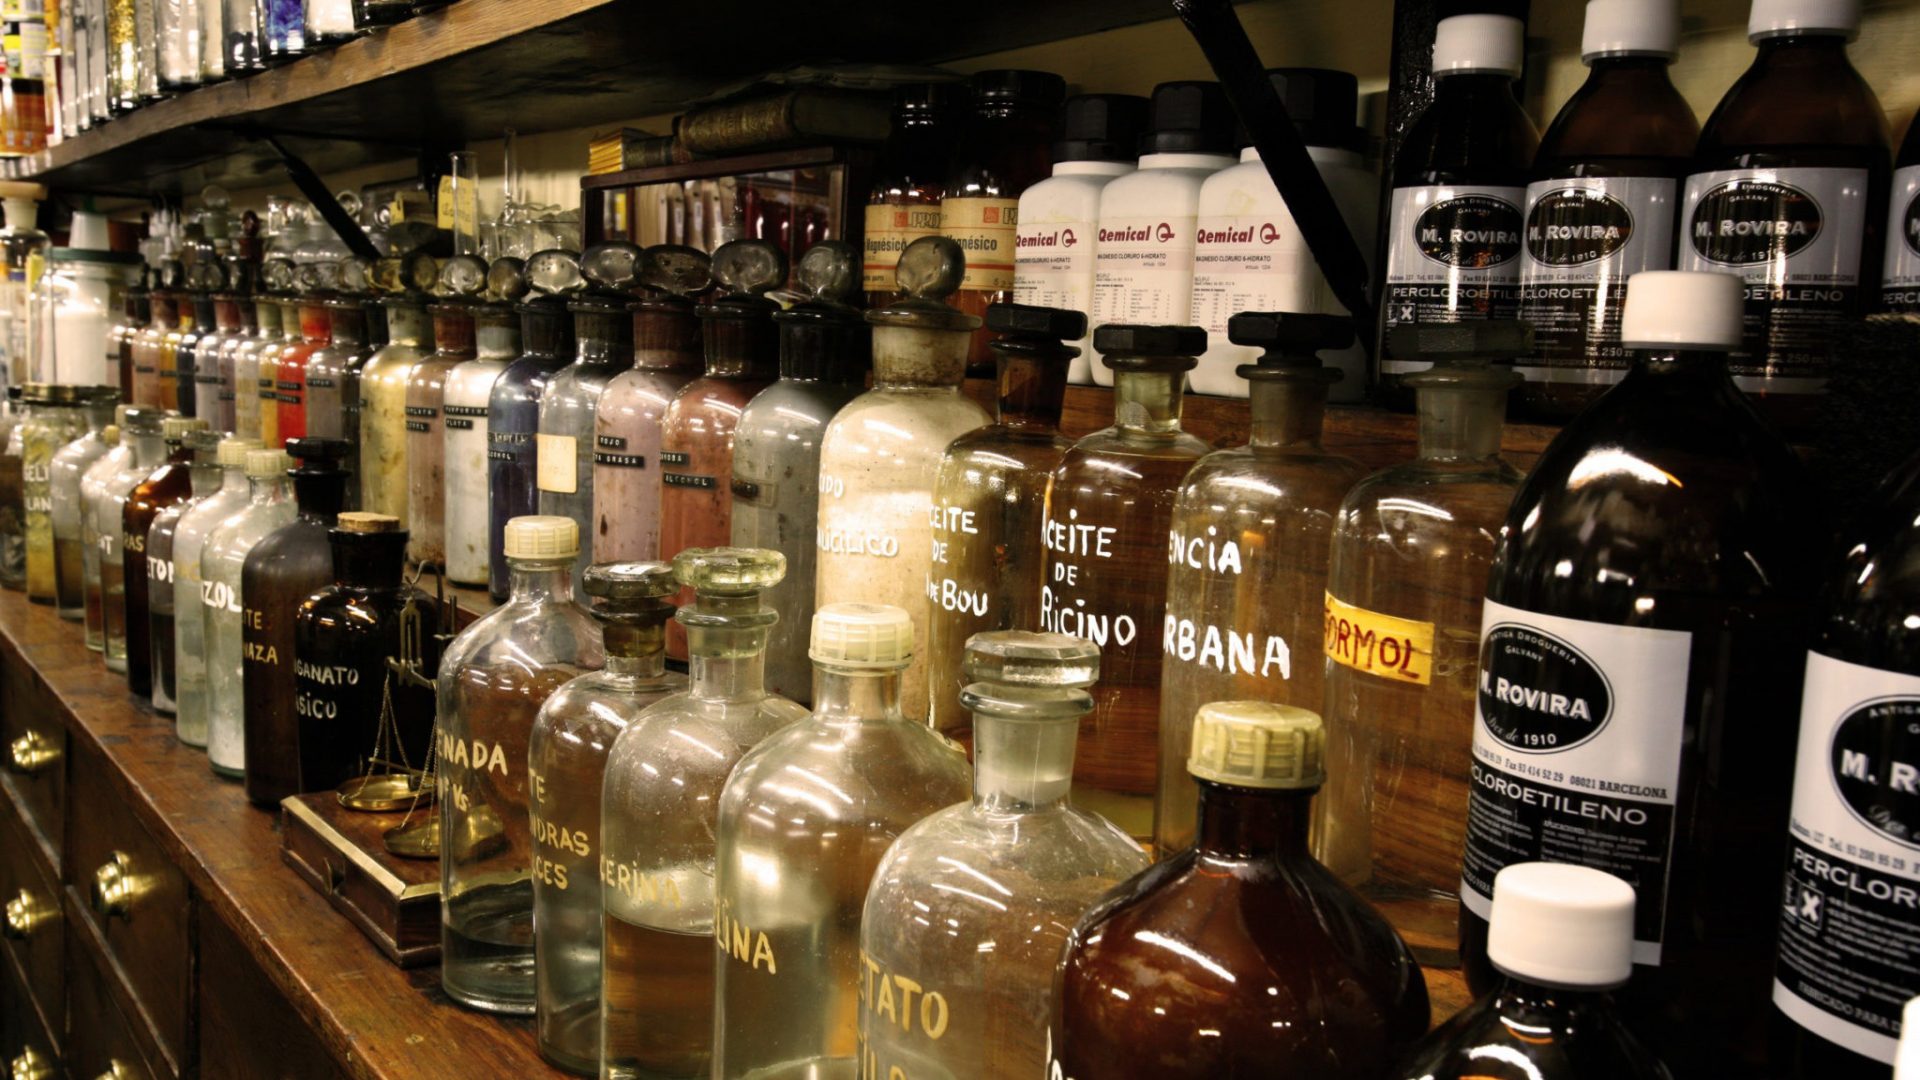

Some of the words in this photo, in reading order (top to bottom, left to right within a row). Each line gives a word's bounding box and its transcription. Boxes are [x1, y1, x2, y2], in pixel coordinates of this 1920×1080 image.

[1098, 225, 1152, 242] Qemical
[1197, 226, 1255, 243] Qemical
[1421, 227, 1444, 244] M.
[1449, 228, 1519, 244] ROVIRA
[1546, 225, 1620, 240] ROVIRA
[1695, 221, 1713, 238] M.
[1720, 219, 1808, 236] ROVIRA
[1055, 562, 1079, 587] DE
[1504, 644, 1544, 663] GALVANY
[1516, 630, 1578, 666] DROGUERIA
[1495, 676, 1592, 723] ROVIRA
[1523, 732, 1557, 746] 1910
[1840, 747, 1879, 786] M.
[1527, 765, 1541, 778] 414
[1552, 771, 1564, 783] 29
[1569, 774, 1596, 789] 08021
[1598, 776, 1668, 799] BARCELONA
